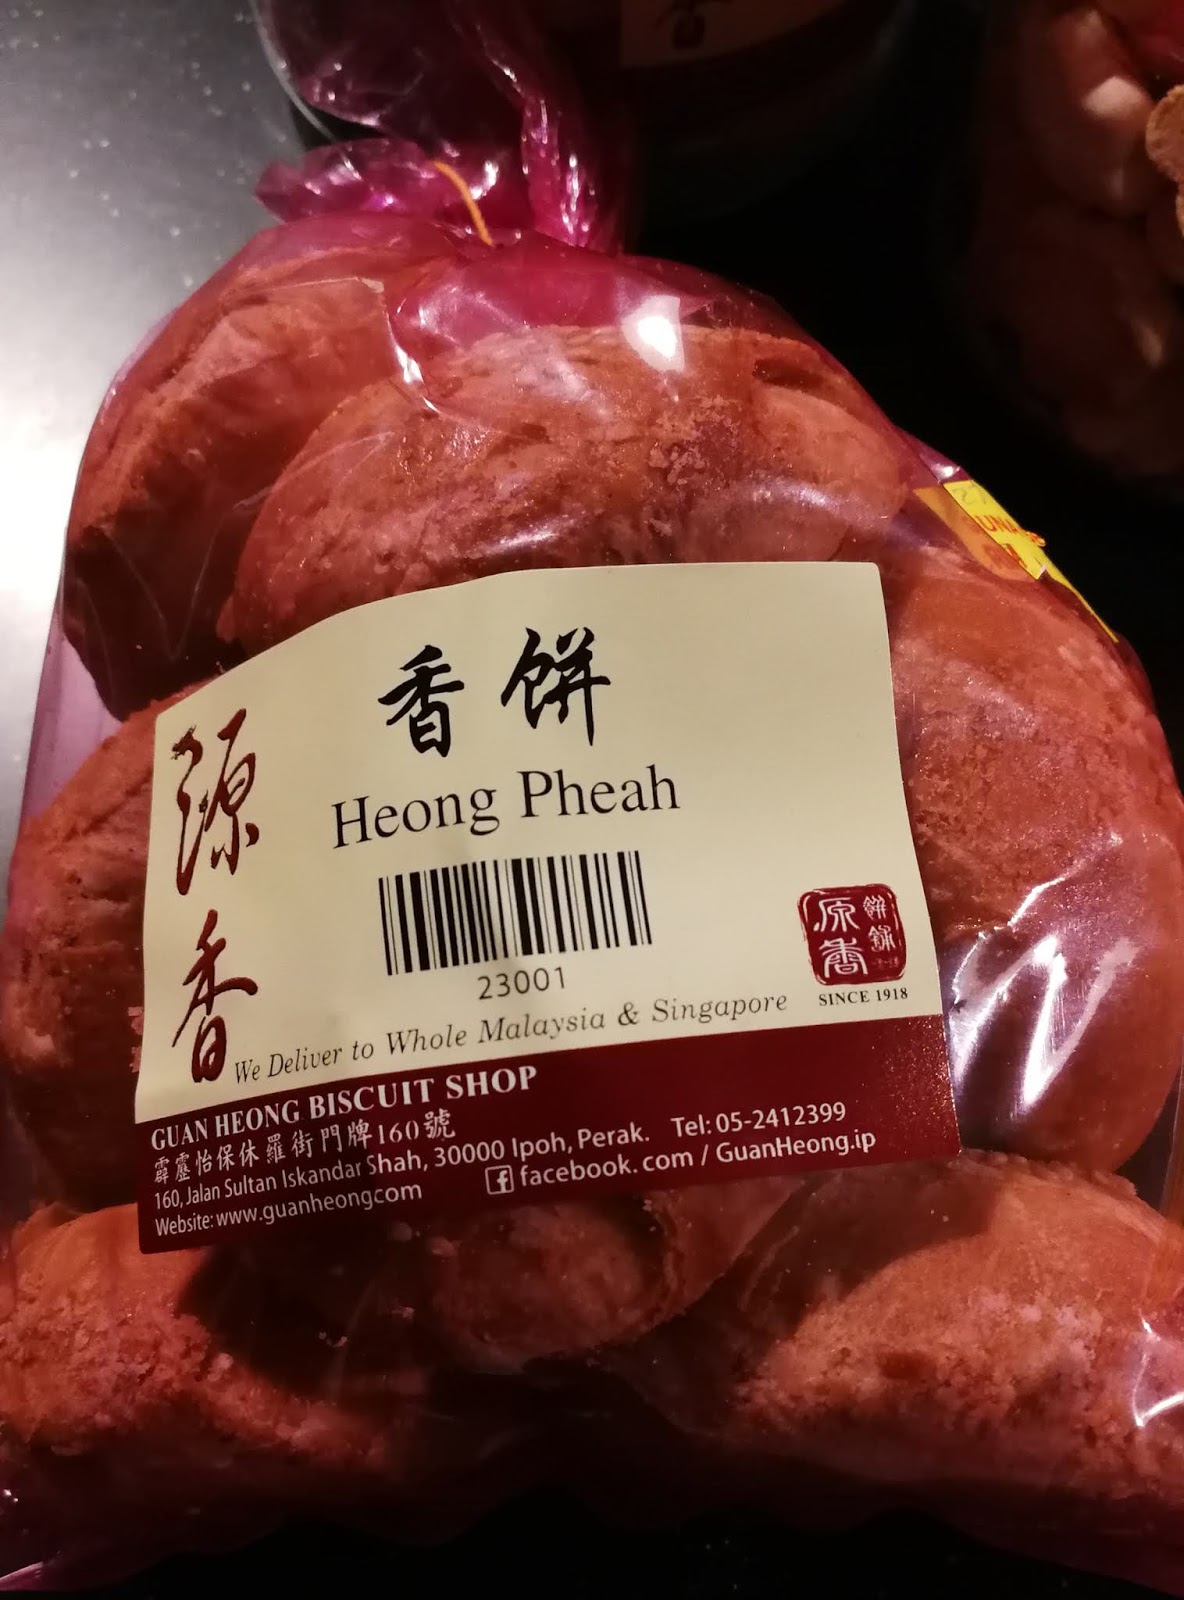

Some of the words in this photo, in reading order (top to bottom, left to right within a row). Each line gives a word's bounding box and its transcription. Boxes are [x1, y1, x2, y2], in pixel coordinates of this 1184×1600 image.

[377, 626, 612, 758] 香餅
[331, 788, 501, 849] Heong
[516, 763, 682, 818] Pheah
[171, 708, 260, 1083] 源香
[477, 966, 566, 1001] 23001
[818, 990, 870, 1007] SINCE
[876, 987, 908, 1002] 1918
[234, 1059, 261, 1084] We
[267, 1046, 343, 1078] Deliver
[351, 1040, 375, 1062] to
[386, 1024, 468, 1056] Whole
[477, 1007, 606, 1044] Malaysia
[618, 1001, 640, 1027] &
[651, 994, 788, 1025] Singapore
[151, 1118, 209, 1151] GUAN
[215, 1099, 300, 1139] HEONG
[308, 1077, 436, 1120] BISCUIT
[445, 1065, 538, 1099] SHOP
[671, 1112, 712, 1138] Tel:
[715, 1101, 847, 1133] 05-2412399
[715, 1128, 877, 1165] GuanHeong.ip
[154, 1189, 185, 1211] 160,
[185, 1178, 224, 1207] Jalan
[223, 1167, 279, 1199] Sultan
[281, 1157, 363, 1189] Iskandar
[366, 1150, 429, 1178] Shah,
[434, 1140, 506, 1168] 30000
[511, 1131, 573, 1163] Ipoh,
[578, 1122, 650, 1149] Perak.
[154, 1209, 214, 1237] Website:
